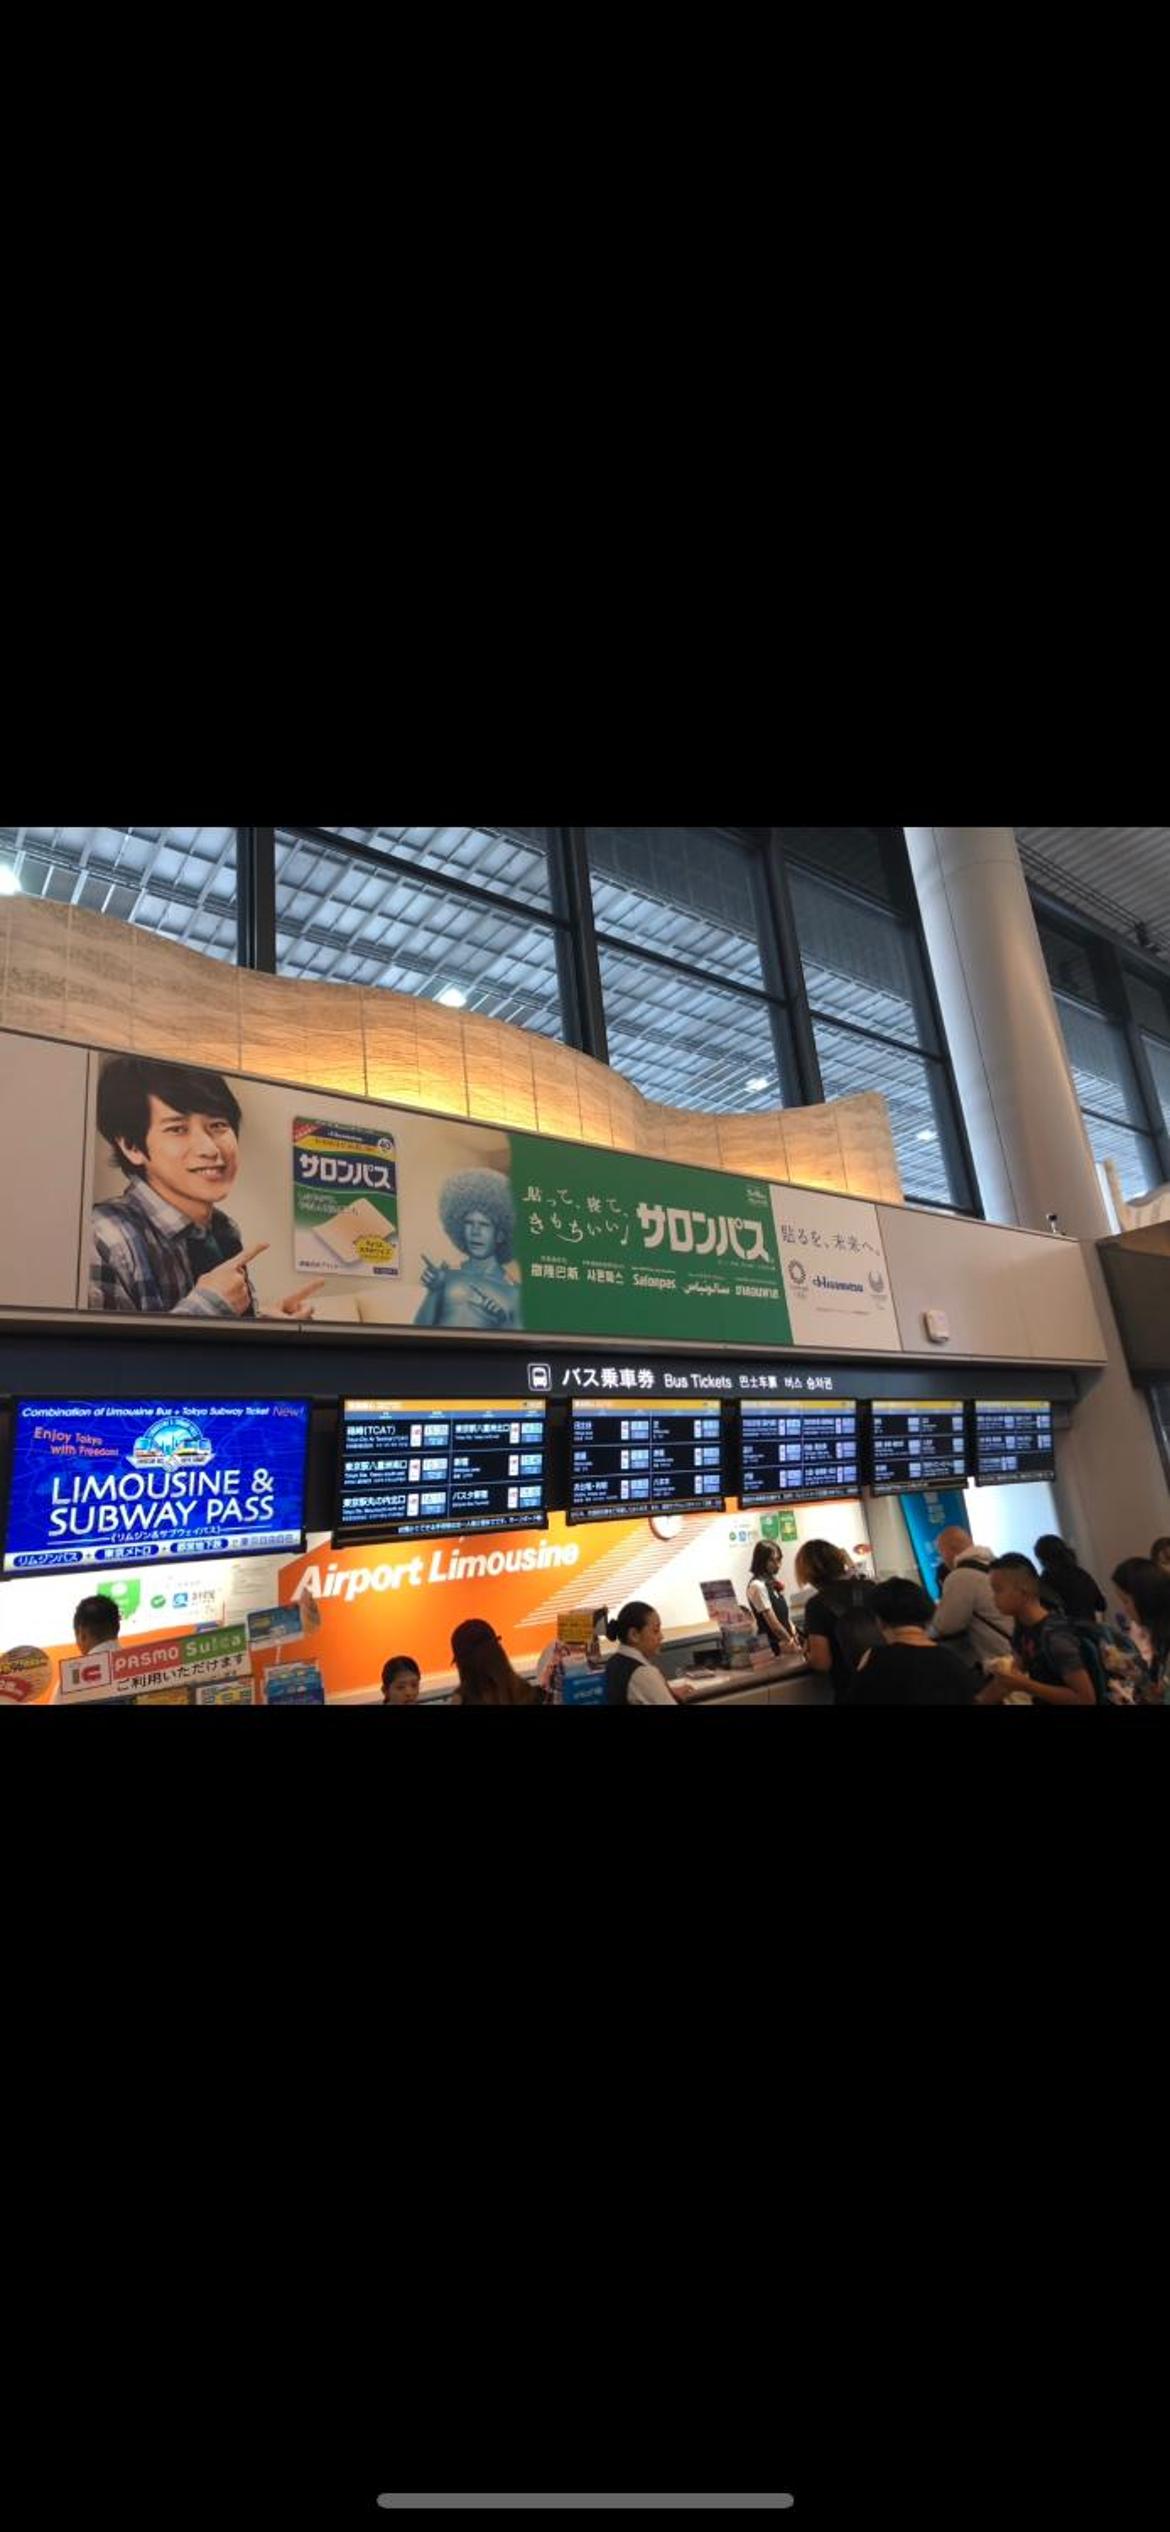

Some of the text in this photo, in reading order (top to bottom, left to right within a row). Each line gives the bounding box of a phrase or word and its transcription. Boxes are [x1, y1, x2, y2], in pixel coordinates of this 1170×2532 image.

[299, 1152, 392, 1190] サロンパス
[635, 1202, 770, 1263] サロンパス
[631, 1273, 677, 1290] Salonpas
[561, 1367, 655, 1389] バス乗車券
[663, 1373, 732, 1389] Bus Tickets
[22, 1407, 91, 1417] Combination
[94, 1407, 104, 1416] of
[105, 1406, 154, 1417] Limousine
[155, 1406, 172, 1416] Bus
[182, 1406, 208, 1416] Tokyo
[208, 1406, 244, 1417] Subway
[245, 1406, 270, 1416] Ticket
[271, 1405, 304, 1418] New!
[33, 1426, 103, 1446] Enjoy Tokyo
[50, 1445, 119, 1457] with Freedom
[51, 1468, 275, 1505] LIMOUSINE &
[48, 1495, 275, 1537] SUBWAY PASS
[289, 1539, 580, 1602] Airport Limousine
[115, 1635, 242, 1671] PASMO Suica
